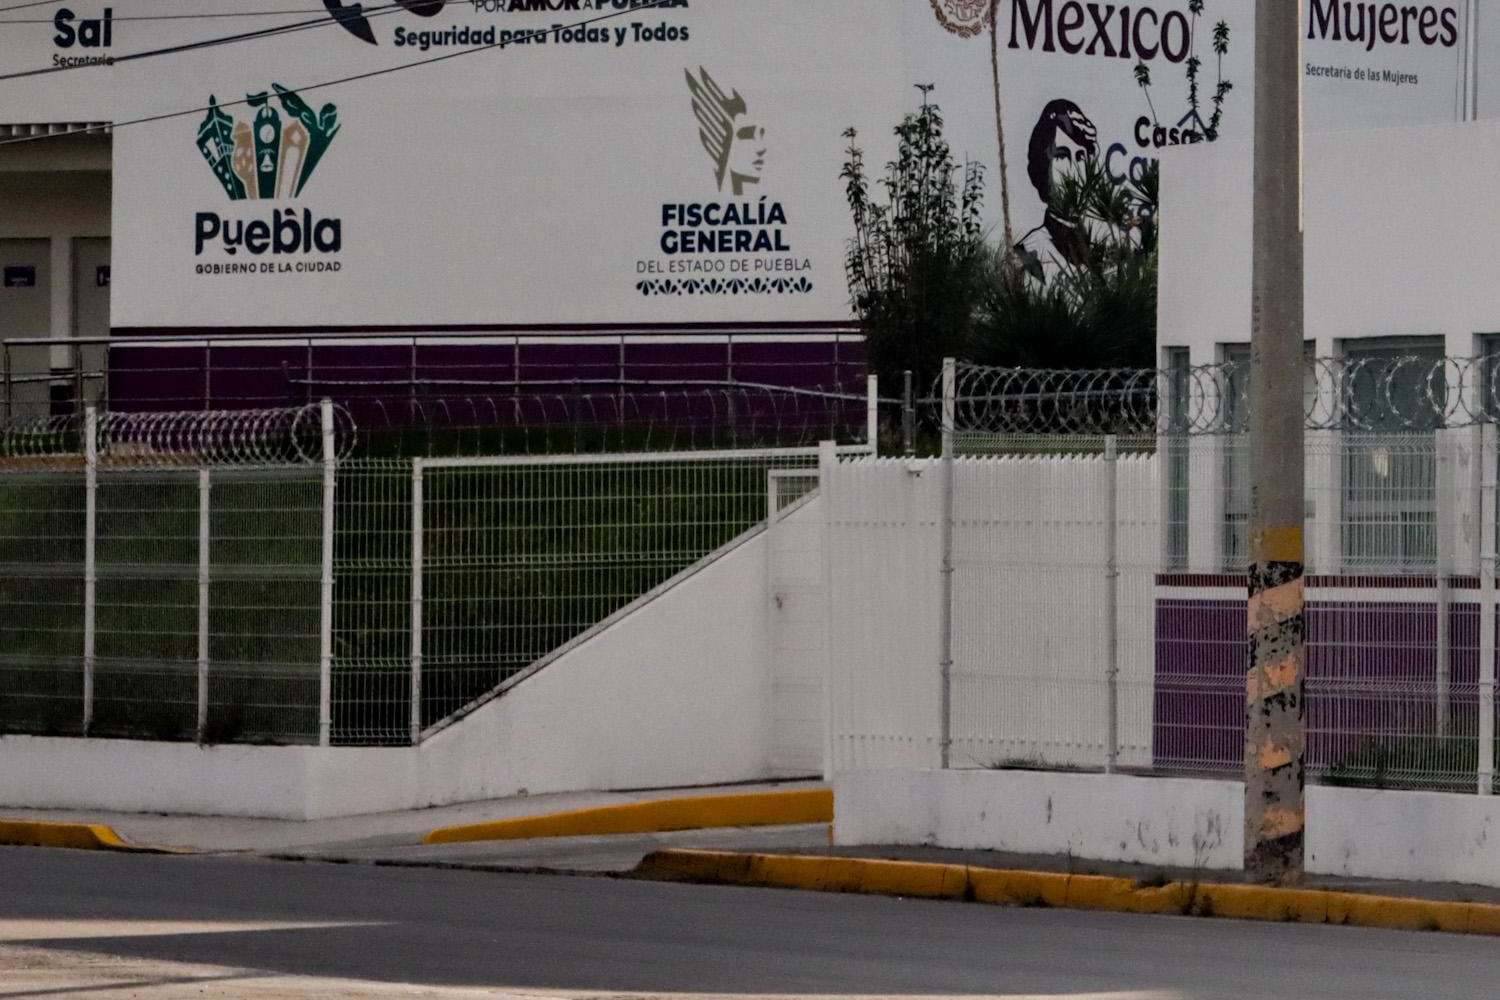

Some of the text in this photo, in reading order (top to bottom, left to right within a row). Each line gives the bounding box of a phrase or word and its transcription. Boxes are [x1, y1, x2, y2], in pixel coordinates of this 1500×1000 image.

[53, 8, 112, 48] Sal
[394, 22, 690, 51] Seguridad para Todas y Todos
[1354, 67, 1365, 80] de
[1367, 68, 1380, 81] las
[1383, 69, 1418, 86] Mujeres
[662, 195, 787, 227] FISCALÍA
[195, 207, 341, 256] Puebla
[660, 229, 790, 255] GENERAL
[195, 261, 341, 275] GOBIERNO DE LA CIUDAD
[636, 258, 812, 273] DEL ESTADO DE PUEBLA
